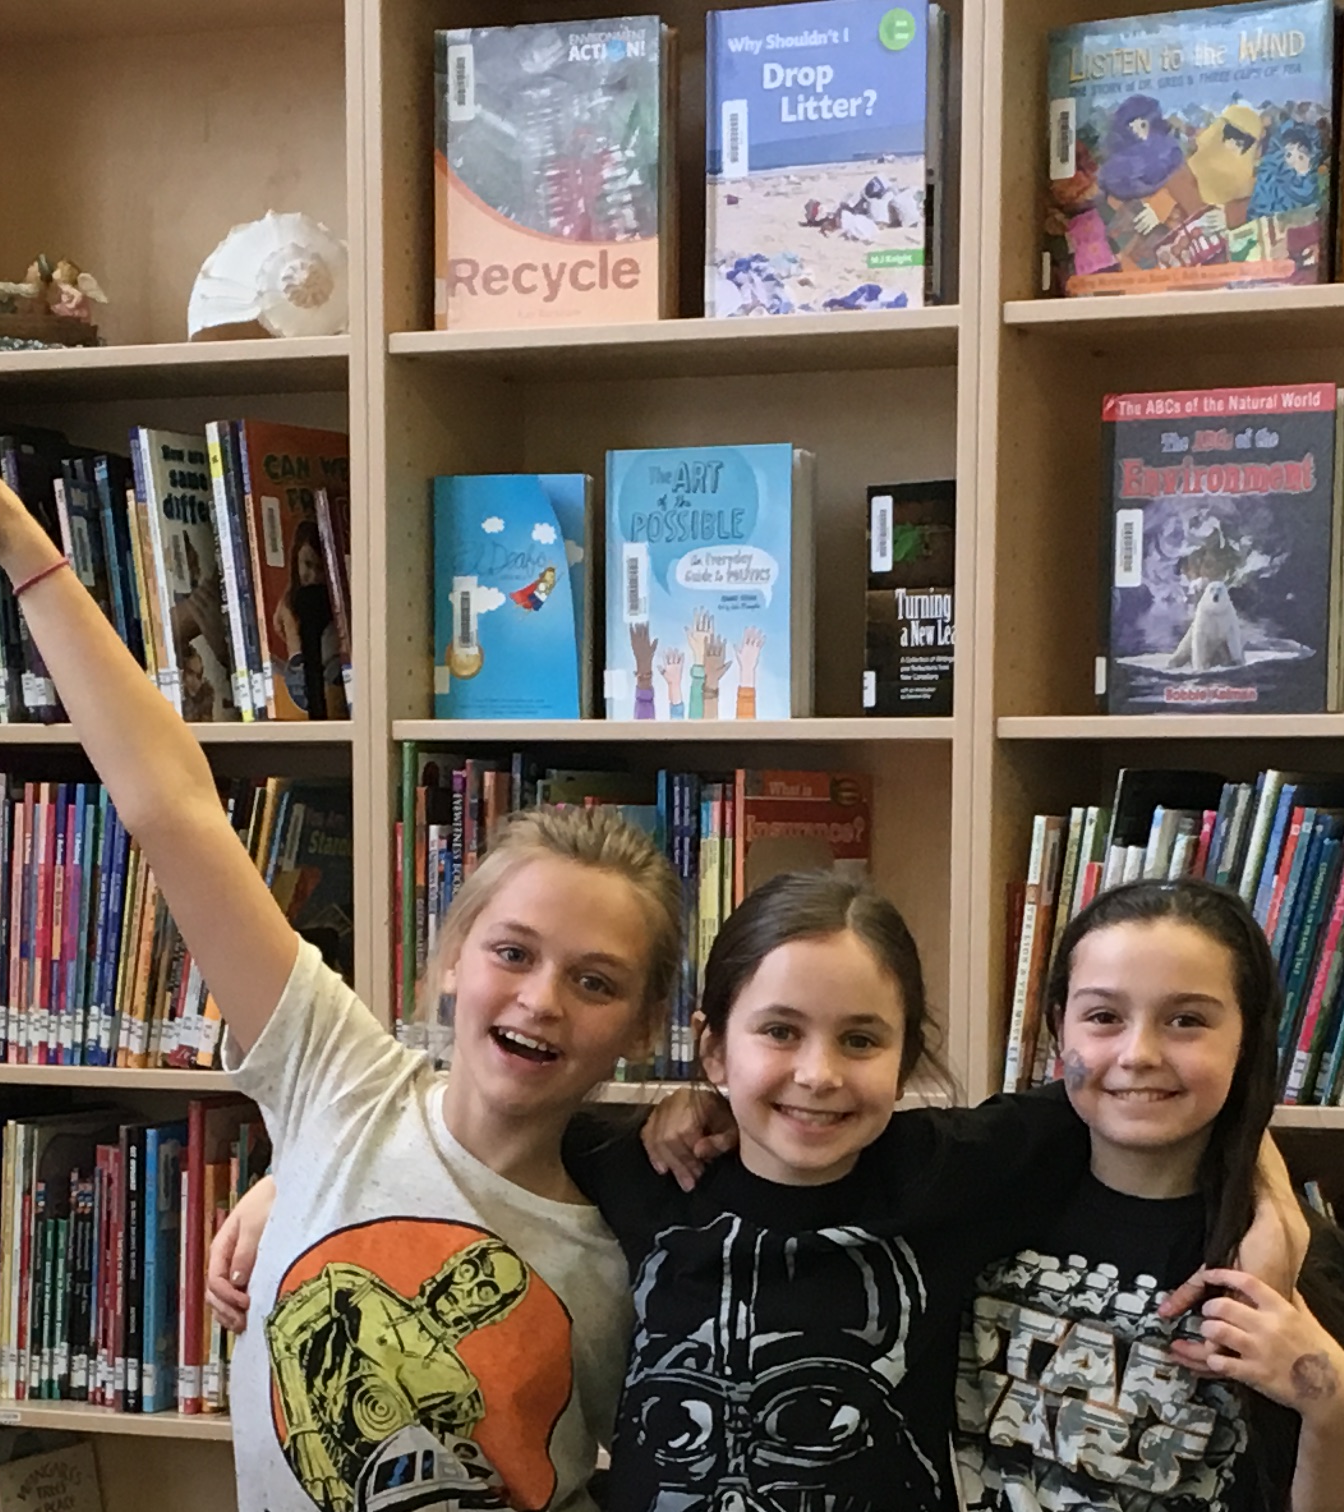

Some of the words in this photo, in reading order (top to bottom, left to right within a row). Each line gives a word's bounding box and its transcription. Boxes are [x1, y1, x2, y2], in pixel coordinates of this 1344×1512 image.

[727, 35, 762, 55] Why
[766, 30, 837, 51] Shouldn't
[1068, 46, 1152, 83] LISTEN
[1160, 46, 1183, 72] to
[1192, 42, 1227, 67] the
[1238, 28, 1306, 63] WIND
[761, 61, 834, 92] Drop
[780, 89, 878, 123] Litter?
[447, 248, 643, 303] Recycle
[1118, 399, 1142, 417] The
[1145, 397, 1181, 416] ABCs
[1185, 396, 1199, 413] of
[1202, 395, 1225, 412] the
[1228, 391, 1278, 410] Natural
[1281, 389, 1321, 409] World
[1160, 431, 1189, 453] The
[264, 453, 310, 480] CAN
[672, 460, 725, 494] ART
[1119, 452, 1317, 499] Environment
[630, 507, 746, 544] POSSIBLE
[894, 587, 953, 623] Turning
[899, 626, 909, 648] a
[909, 620, 936, 648] New
[452, 793, 462, 859] EYEWITNESS
